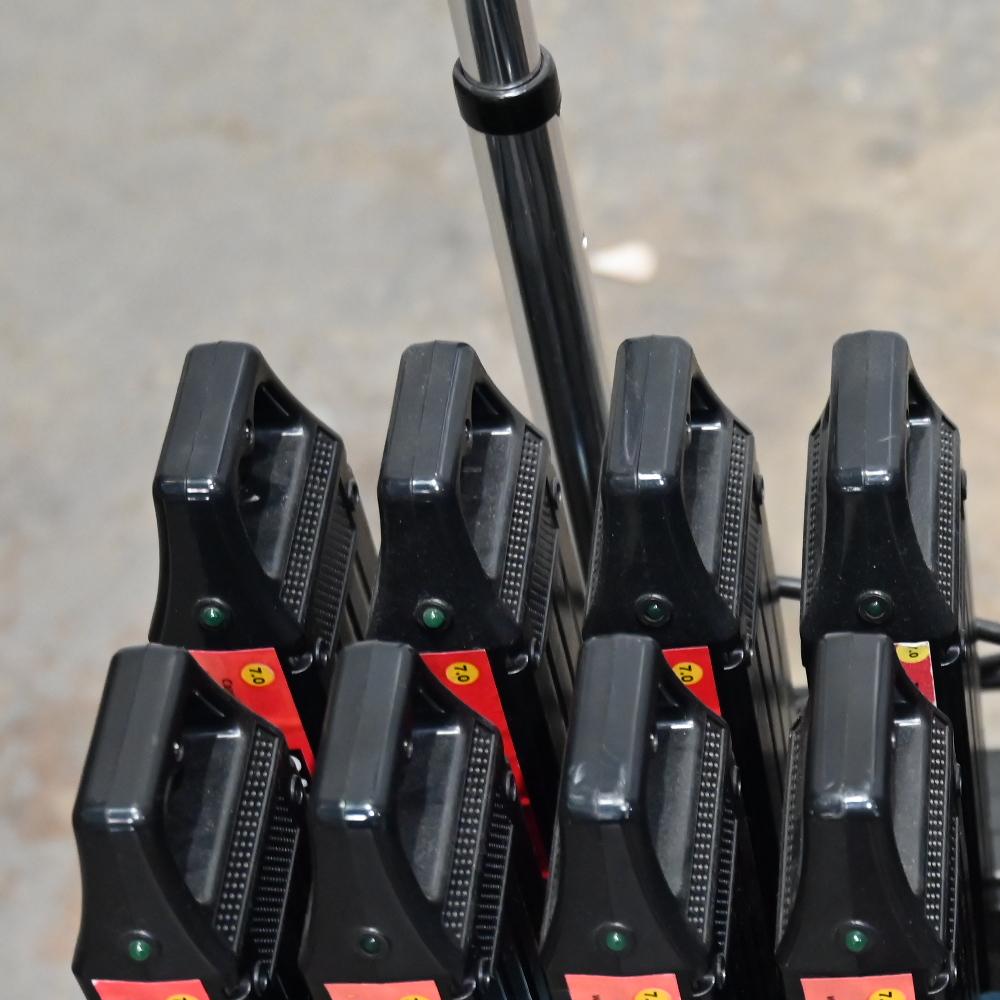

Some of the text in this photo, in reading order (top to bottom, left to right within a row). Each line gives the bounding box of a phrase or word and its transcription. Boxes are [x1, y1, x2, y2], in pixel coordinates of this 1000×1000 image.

[249, 667, 266, 685] 7.0
[454, 665, 470, 682] 7.0
[679, 664, 692, 682] 7.0
